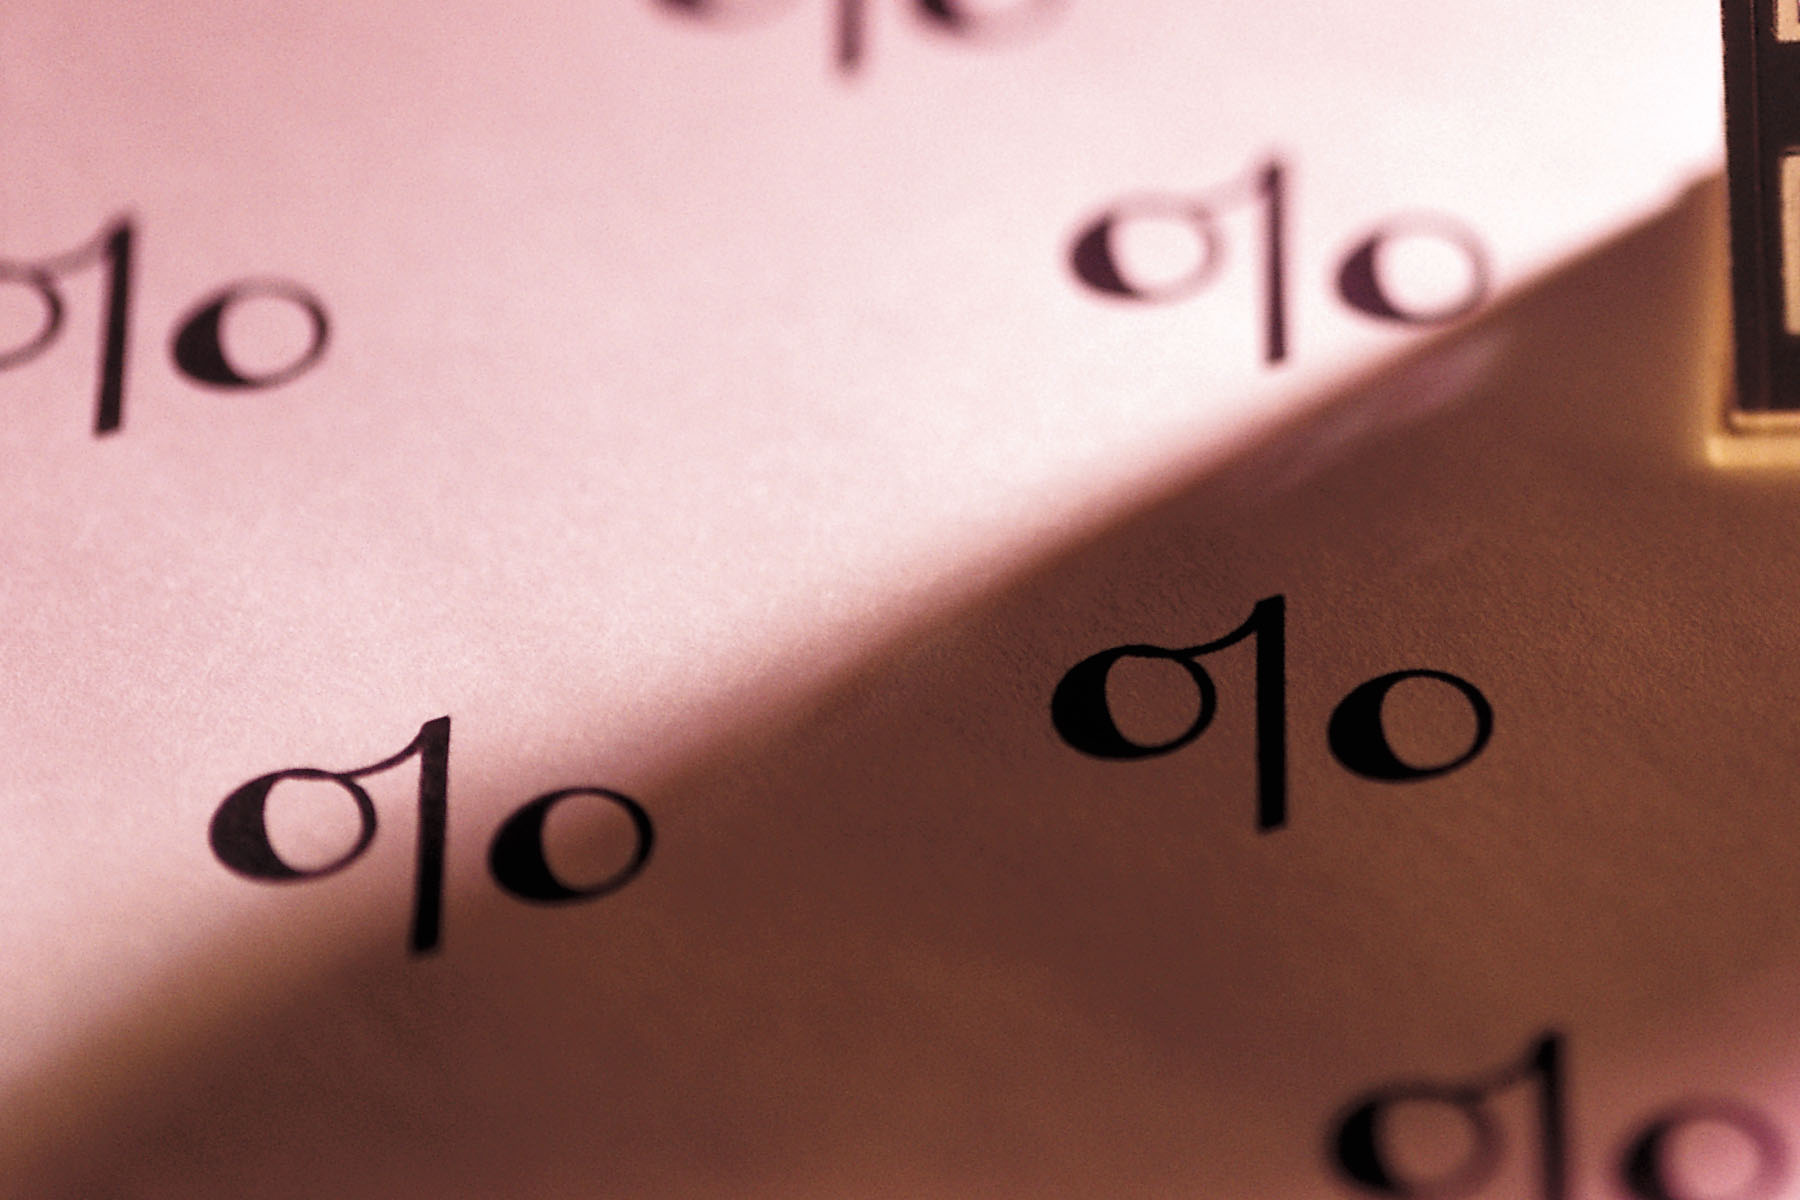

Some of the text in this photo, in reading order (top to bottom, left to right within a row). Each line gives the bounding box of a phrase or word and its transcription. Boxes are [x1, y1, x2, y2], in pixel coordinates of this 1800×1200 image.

[0, 212, 331, 438] %
[1068, 146, 1491, 366] %
[1050, 594, 1494, 833] %
[208, 715, 655, 955] %
[1325, 1029, 1792, 1200] %
